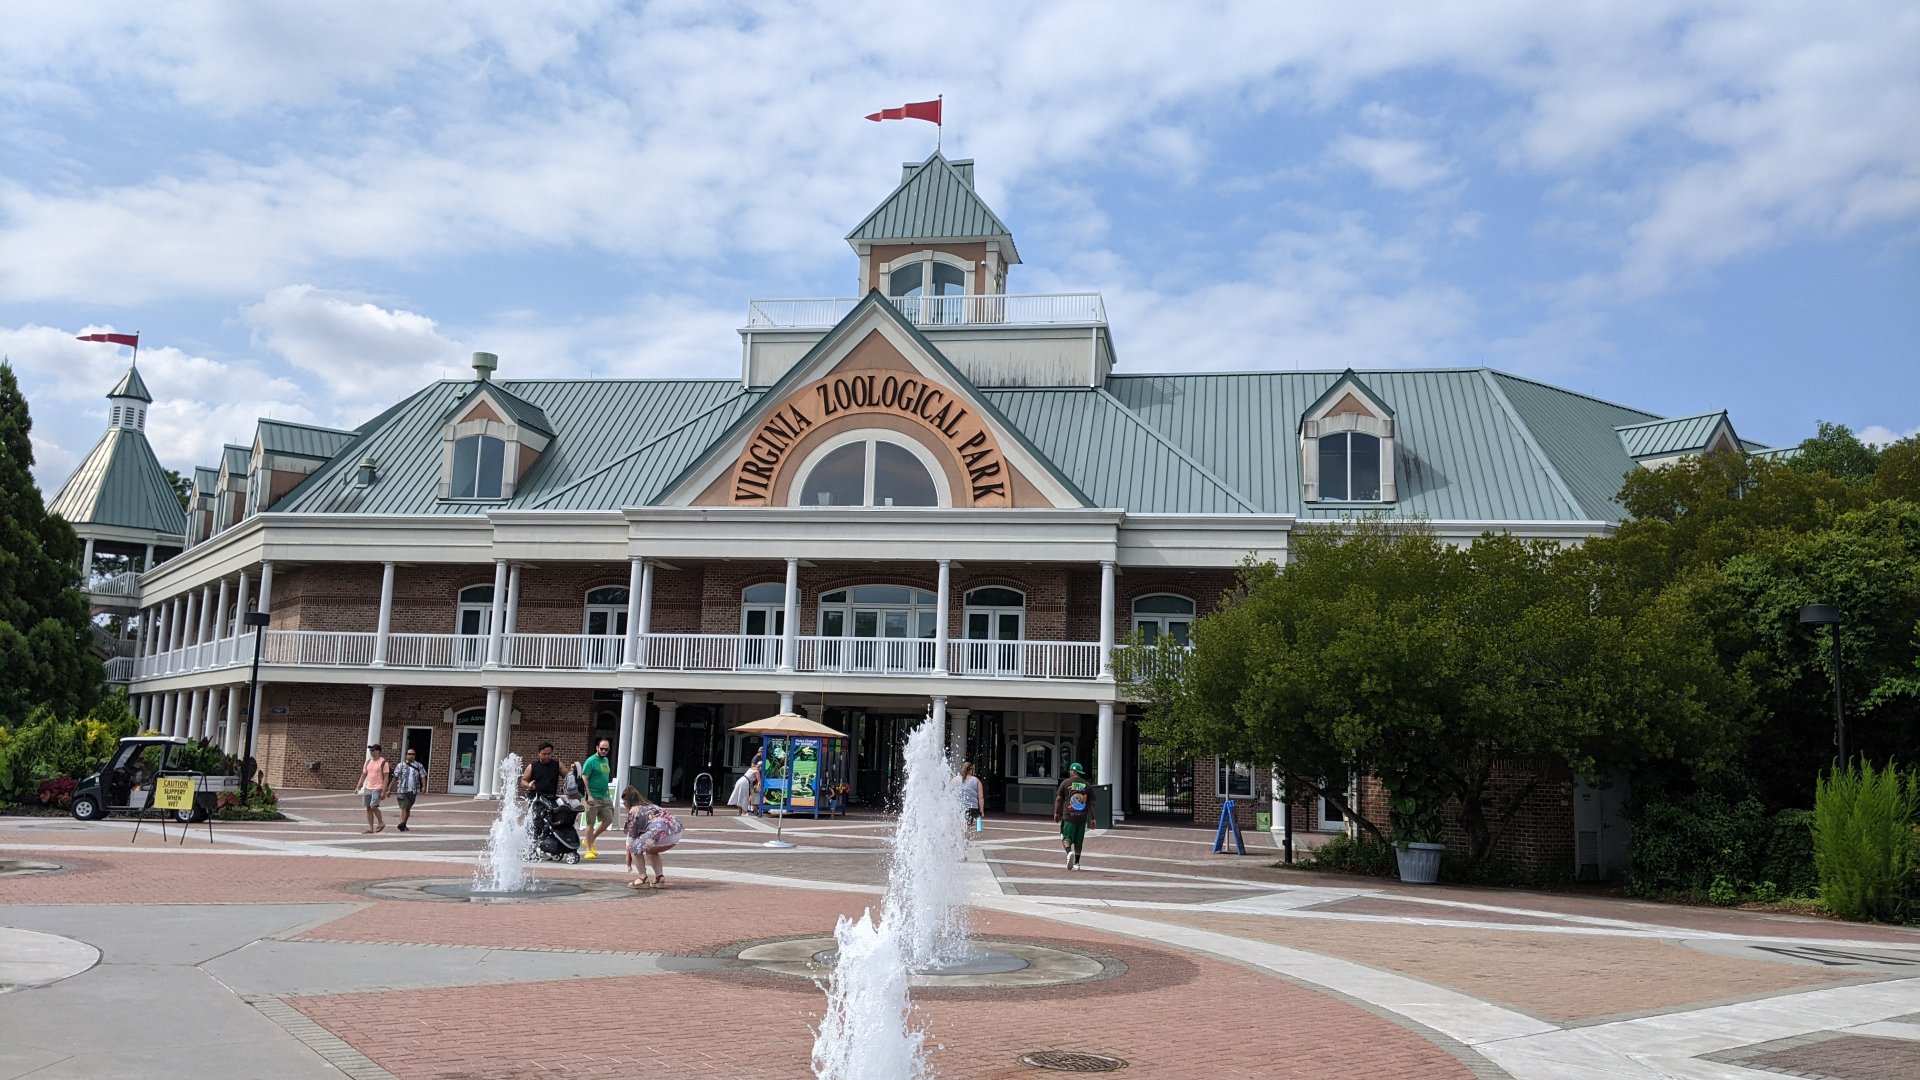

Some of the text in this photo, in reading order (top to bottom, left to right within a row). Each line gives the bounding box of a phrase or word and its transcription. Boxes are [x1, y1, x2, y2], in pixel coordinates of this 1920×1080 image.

[735, 375, 1005, 502] VIRGINIA ZOOLOGICAL PARK
